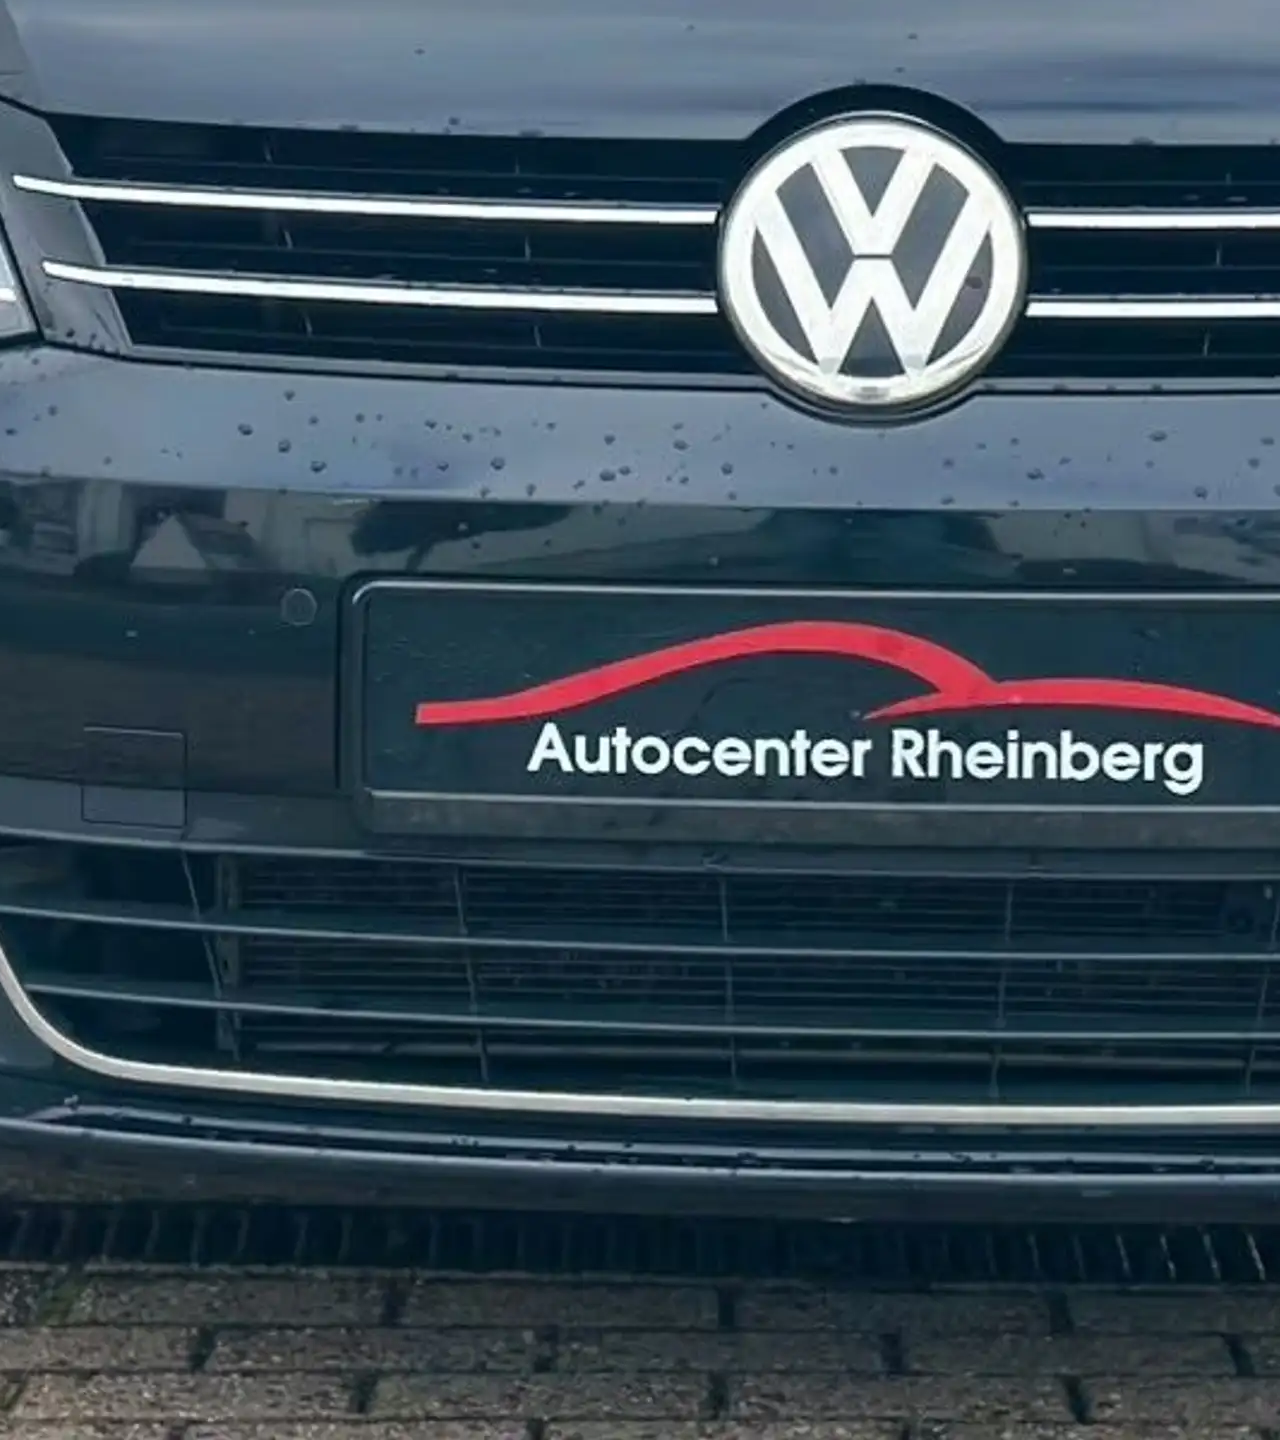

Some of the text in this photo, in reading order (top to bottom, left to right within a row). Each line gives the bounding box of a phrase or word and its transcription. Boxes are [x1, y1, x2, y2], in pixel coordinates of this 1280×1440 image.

[742, 136, 1004, 384] VW
[526, 721, 1206, 797] Autocenter Rheinberg
